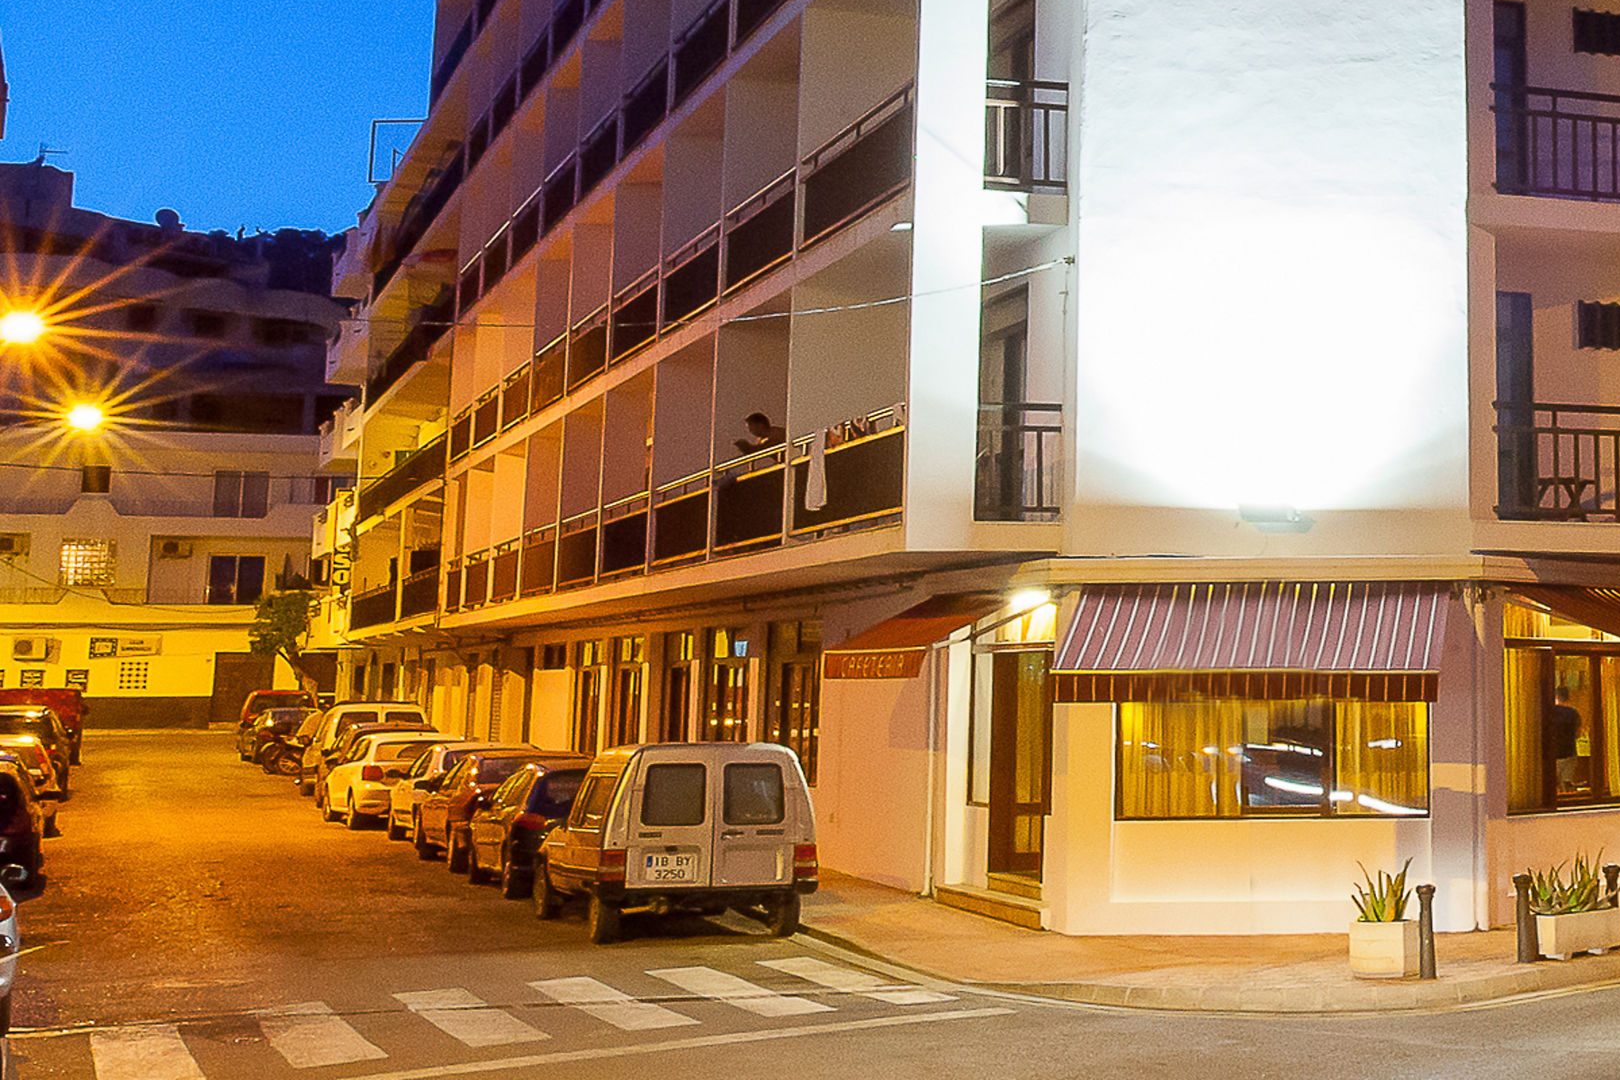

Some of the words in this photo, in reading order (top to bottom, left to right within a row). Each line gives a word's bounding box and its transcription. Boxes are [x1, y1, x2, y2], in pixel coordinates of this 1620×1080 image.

[654, 856, 669, 867] IB
[676, 856, 692, 867] BY
[654, 869, 686, 880] 3250
